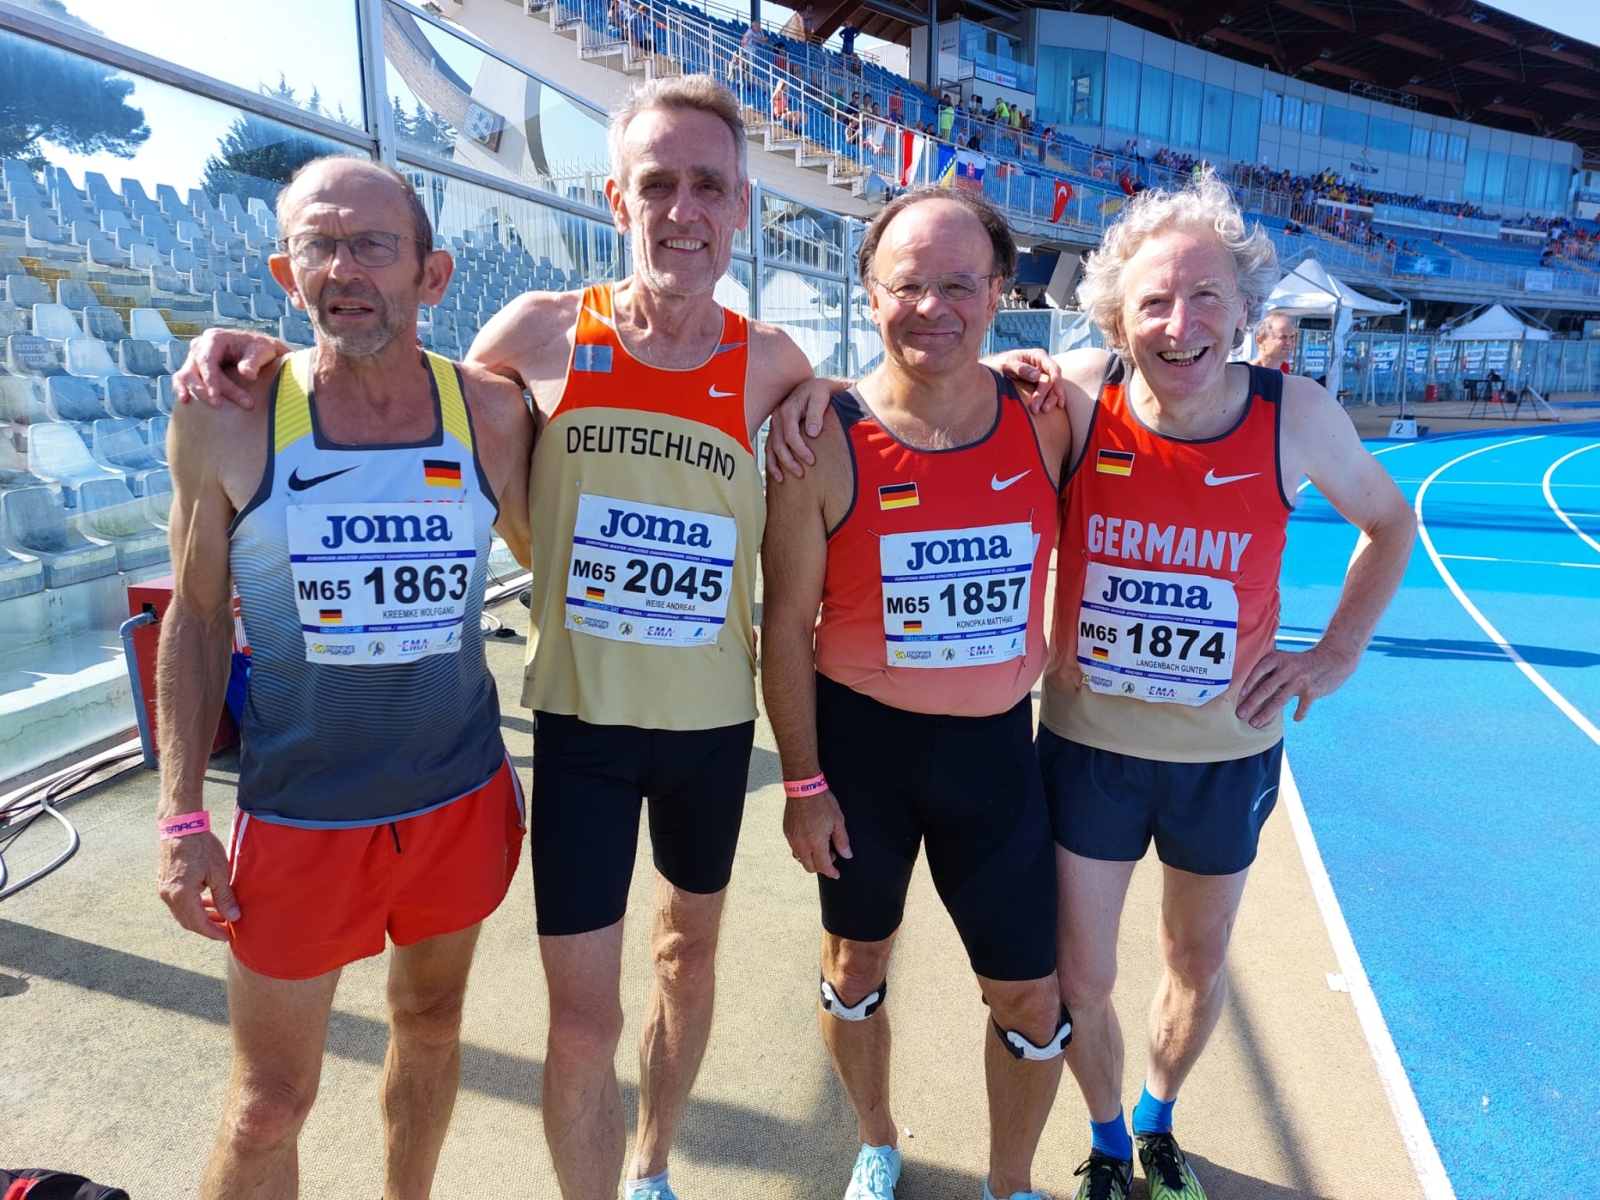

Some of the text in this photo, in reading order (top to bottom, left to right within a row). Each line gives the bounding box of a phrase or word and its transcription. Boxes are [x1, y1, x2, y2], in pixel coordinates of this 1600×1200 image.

[1396, 422, 1404, 434] 2
[567, 425, 736, 481] DEUTSCHLAND
[1088, 514, 1252, 572] GERMANY
[298, 564, 468, 604] M65 1863
[572, 559, 722, 602] M65 2045
[887, 577, 1026, 617] M65 1857
[383, 606, 454, 619] KREEMKE WOLFGANG
[646, 599, 696, 612] WEISE ANDREAS
[957, 615, 1013, 629] KONOPKA MATTHIAS
[647, 626, 672, 637] EMA
[402, 639, 428, 652] EMA
[1080, 622, 1117, 643] M65
[1127, 622, 1225, 664] 1874
[970, 645, 993, 656] EMA
[1136, 658, 1208, 675] LANGENBACH GUNTER
[1149, 686, 1174, 697] EMA
[801, 778, 826, 792] EMAC
